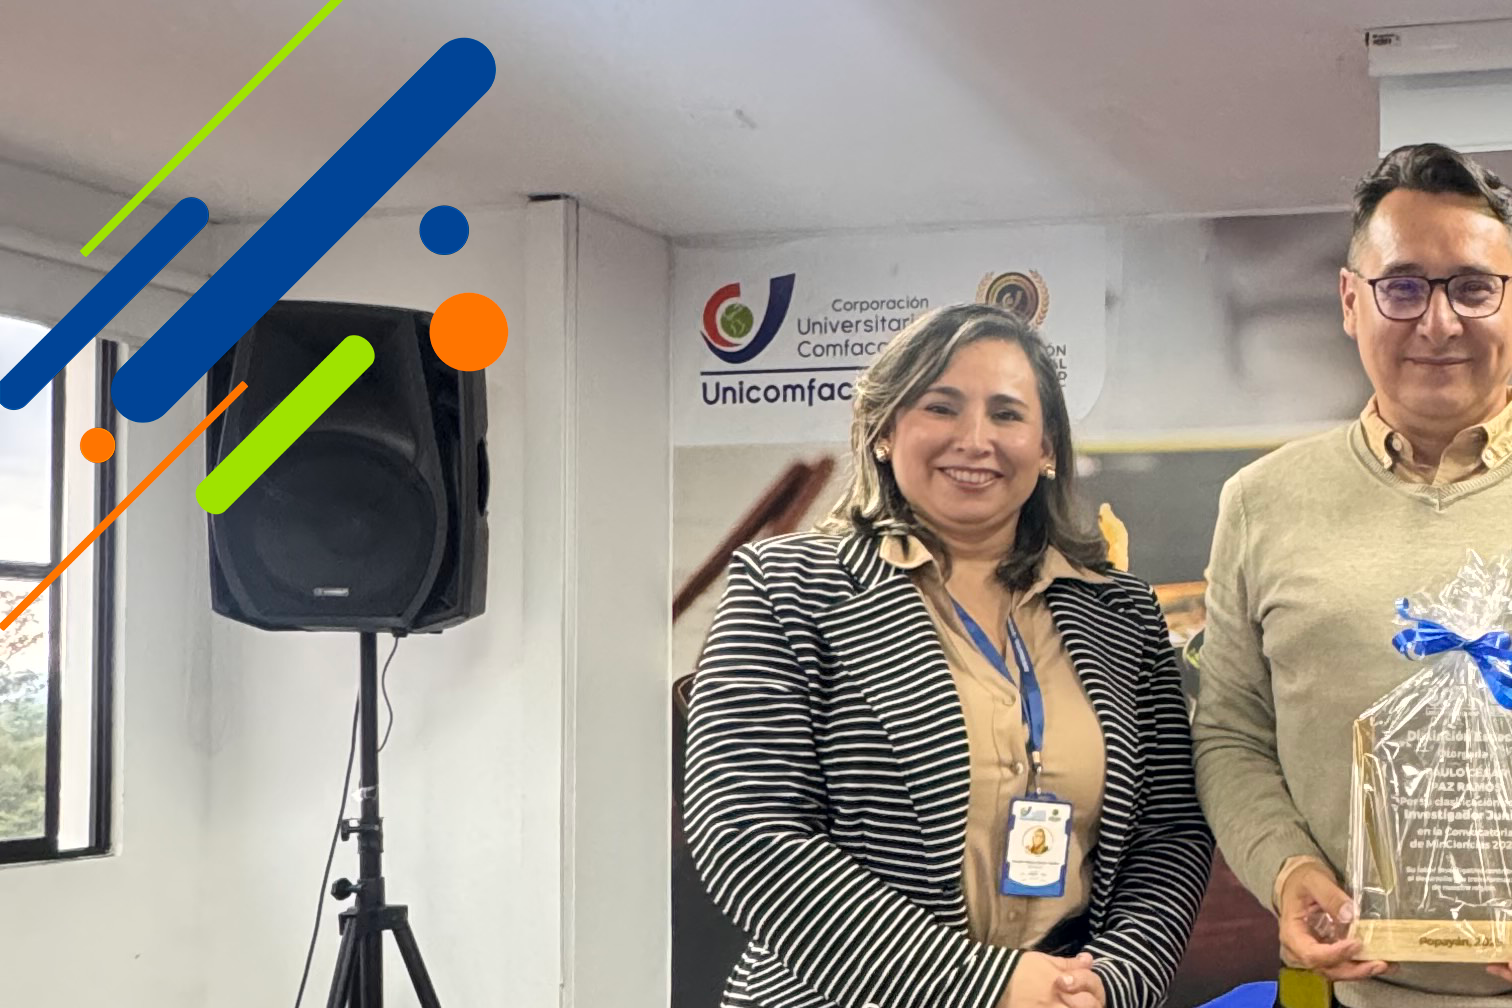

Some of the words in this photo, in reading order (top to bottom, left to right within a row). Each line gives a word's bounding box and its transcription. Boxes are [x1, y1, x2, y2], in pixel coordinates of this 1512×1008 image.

[831, 296, 929, 314] Corporación
[1427, 767, 1466, 778] AULO
[1404, 808, 1484, 822] Investigador
[1409, 840, 1423, 849] de
